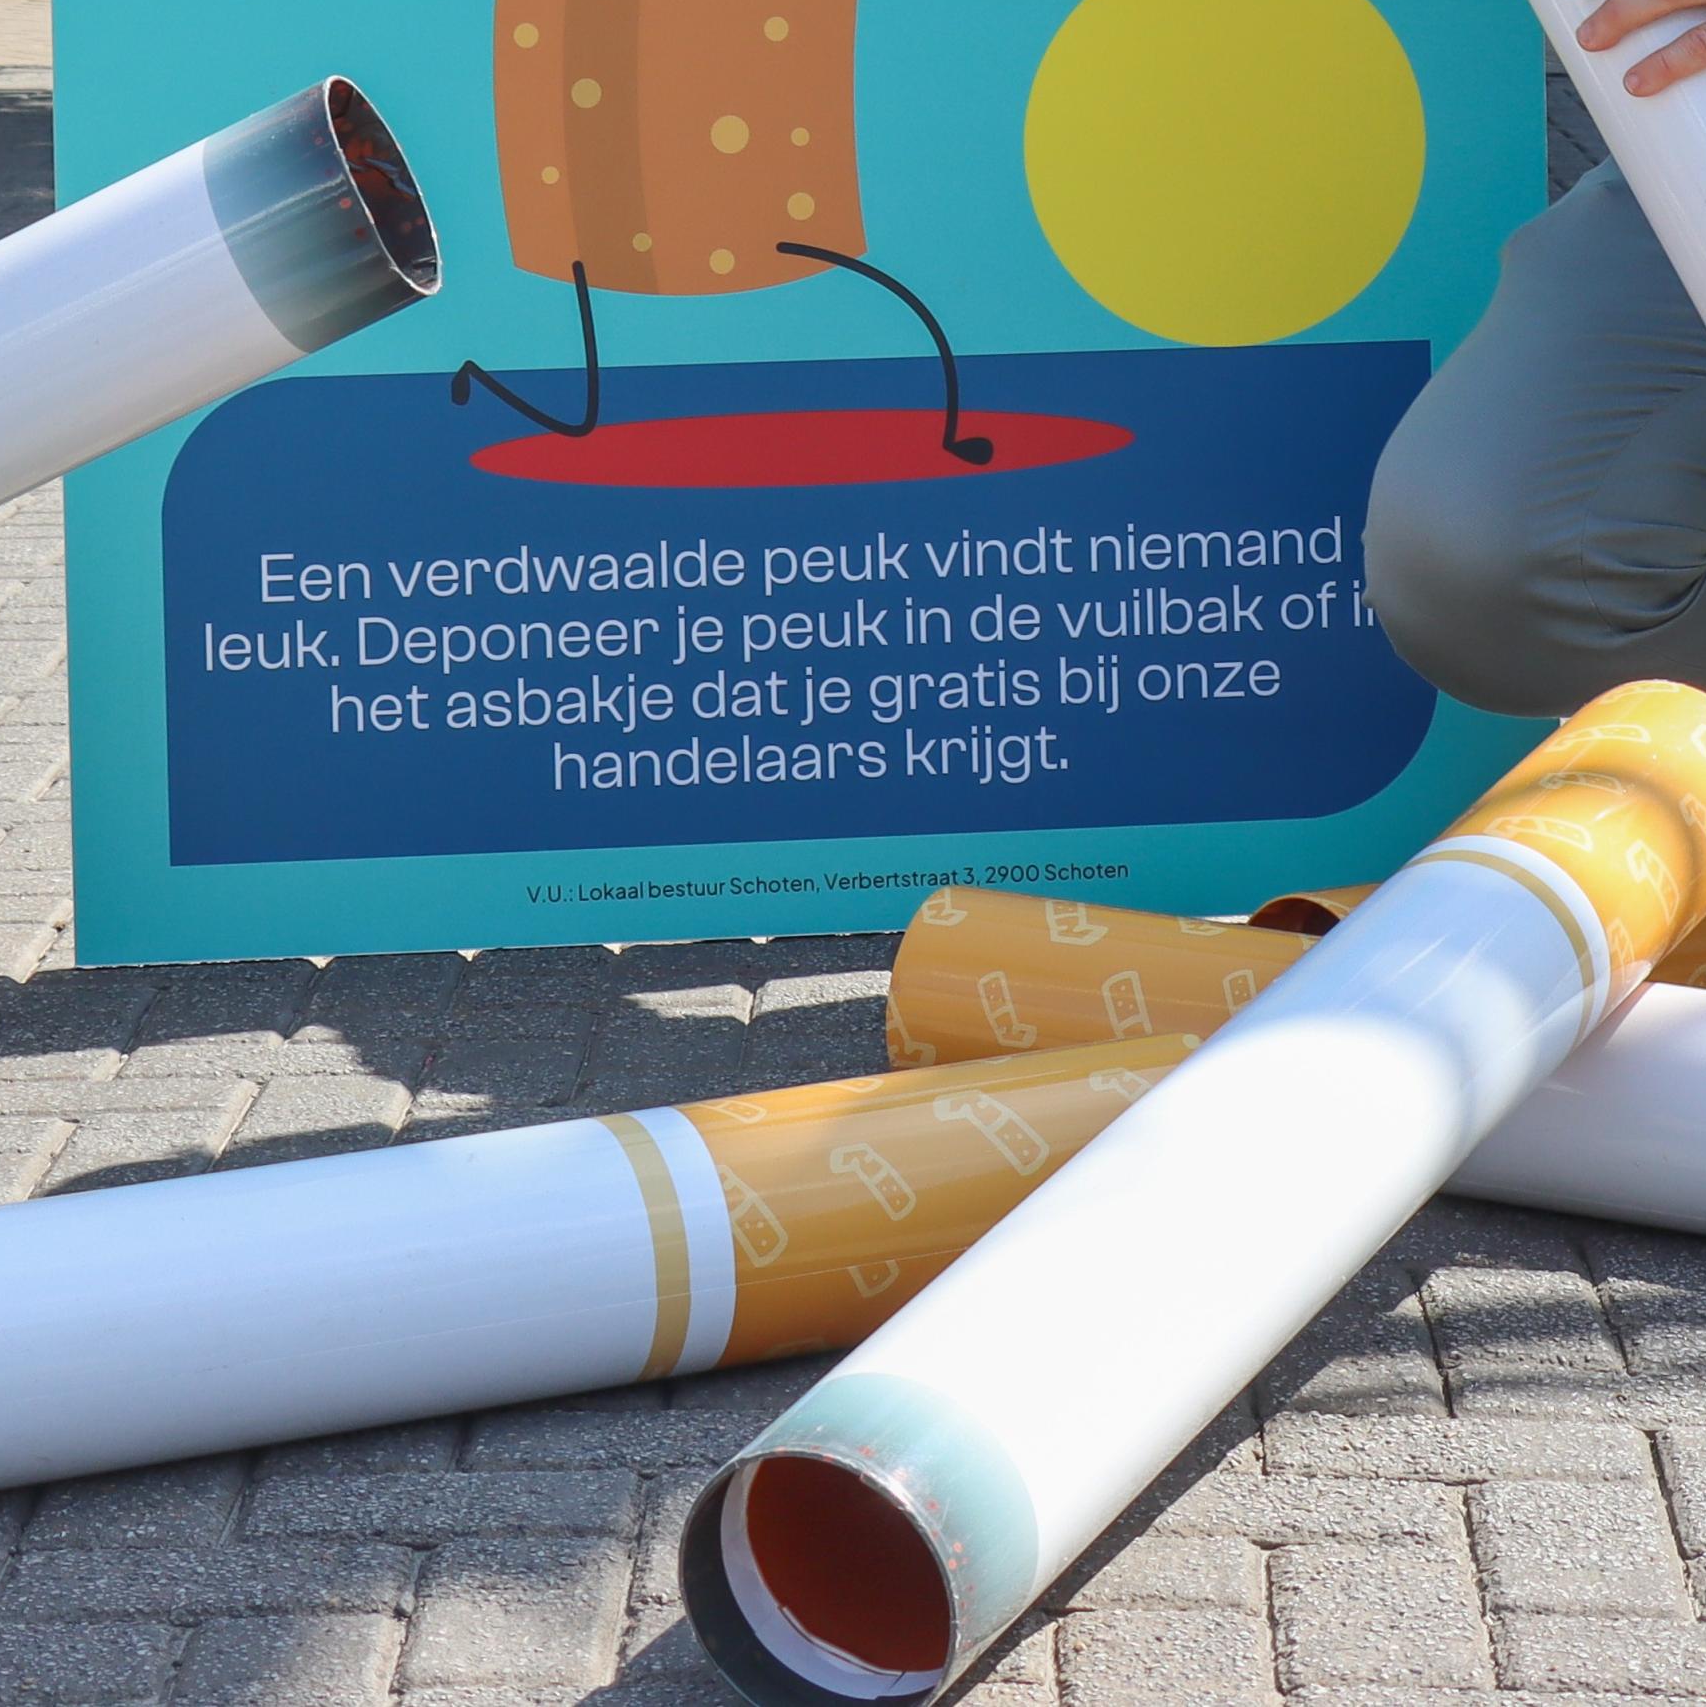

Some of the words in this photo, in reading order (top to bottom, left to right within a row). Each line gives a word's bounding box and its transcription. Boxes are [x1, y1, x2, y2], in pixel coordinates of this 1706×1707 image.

[261, 554, 370, 602] Een
[388, 539, 744, 597] verdwaalde
[765, 533, 910, 595] peuk
[925, 527, 1073, 577] vindt
[1091, 516, 1341, 571] niemand
[206, 620, 339, 670] leuk.
[359, 617, 659, 674] Deponeer
[673, 606, 723, 664] je
[743, 599, 888, 662] peuk
[906, 597, 951, 644] in
[971, 594, 1040, 641] de
[1057, 585, 1263, 637] vuilbak
[1281, 581, 1336, 629] of
[332, 685, 429, 732] het
[447, 674, 673, 732] asbakje
[693, 670, 788, 718] dat
[801, 667, 850, 725] je
[870, 659, 1040, 722] gratis
[1060, 655, 1118, 713] bij
[1138, 661, 1279, 700] onze
[555, 735, 886, 789] handelaars
[906, 725, 1067, 784] krijgt.
[578, 881, 644, 902] Lokaal
[647, 879, 726, 899] bestuur
[729, 875, 821, 895] Schoten,
[823, 867, 960, 891] Verbertstraat
[962, 867, 981, 887] 3,
[984, 864, 1041, 885] 2900
[1043, 862, 1129, 882] Schoten
